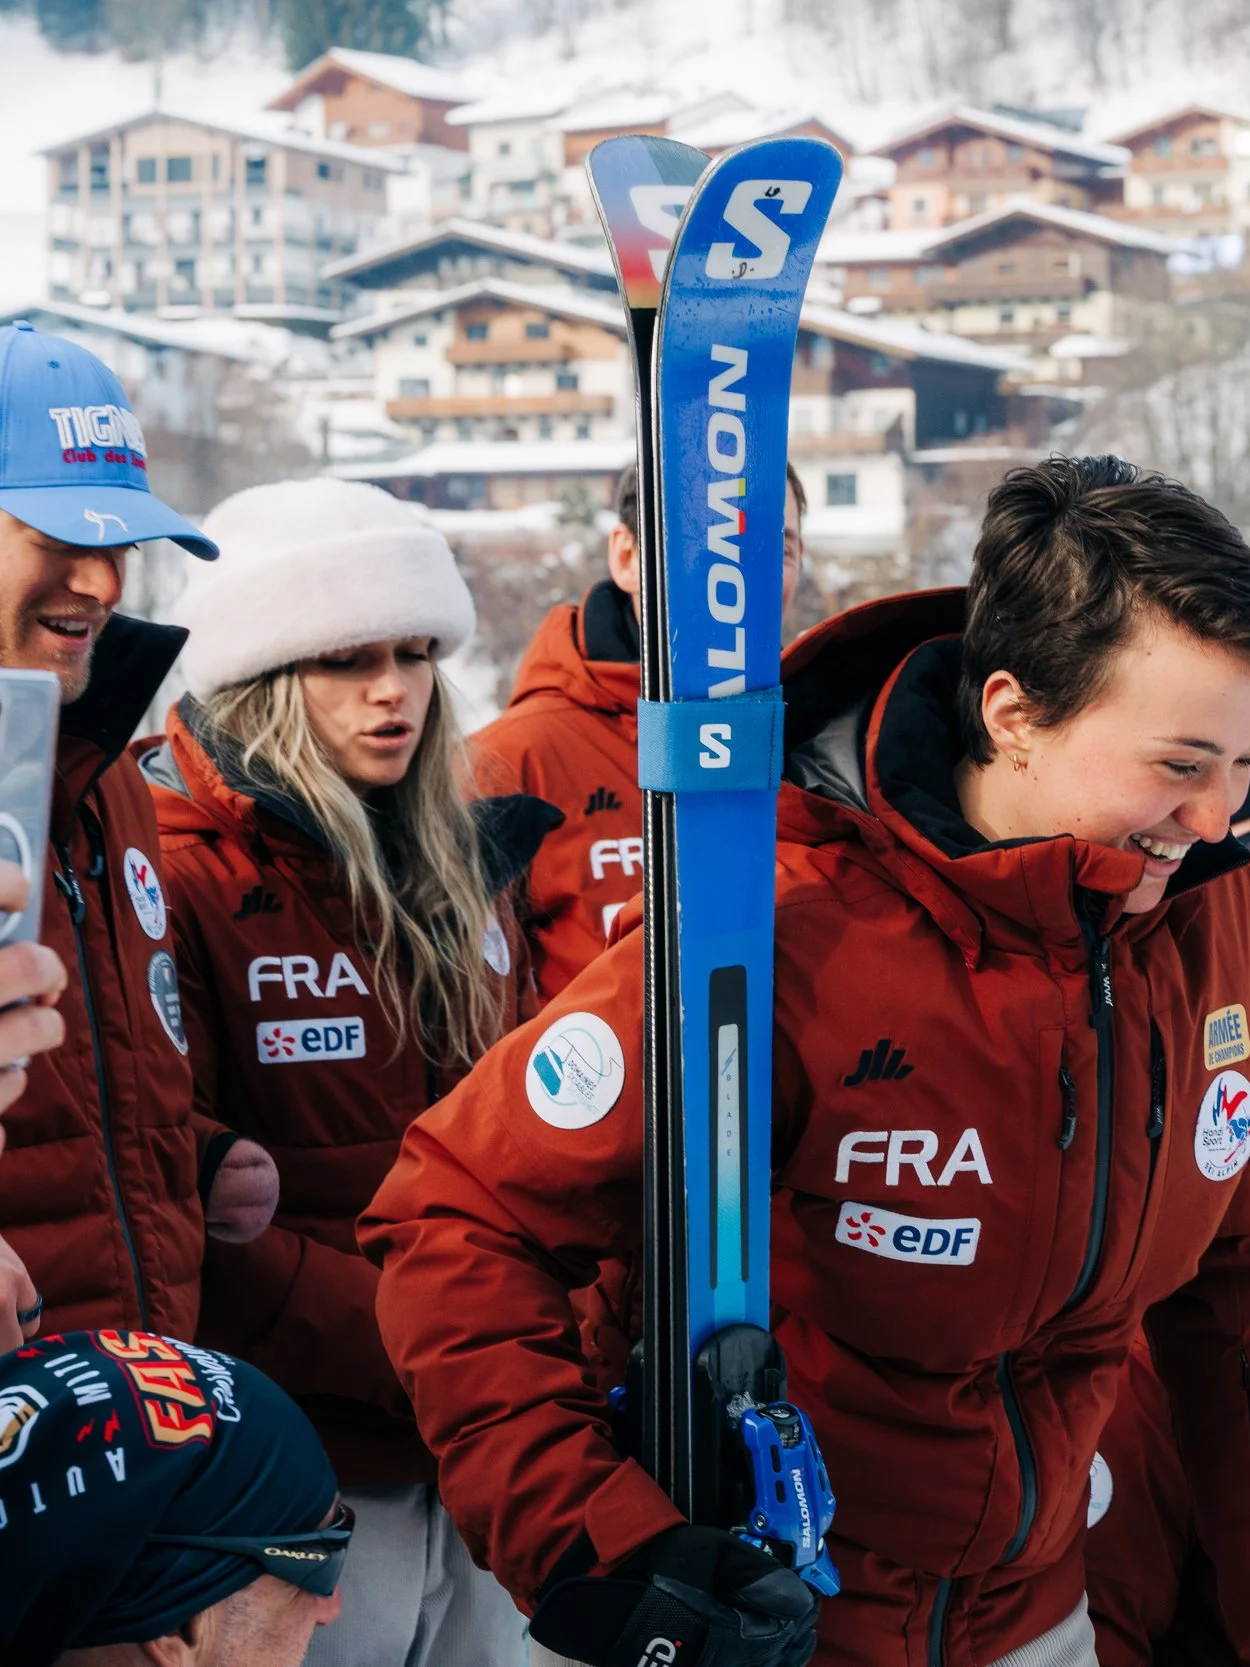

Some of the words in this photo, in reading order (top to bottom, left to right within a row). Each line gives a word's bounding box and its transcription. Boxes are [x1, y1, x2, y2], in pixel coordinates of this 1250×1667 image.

[707, 343, 749, 698] LOMON
[699, 723, 732, 769] S
[589, 837, 644, 880] FR
[247, 952, 370, 1002] FRA
[1208, 1009, 1243, 1050] ARMÉE
[834, 1127, 994, 1187] FRA
[791, 1468, 811, 1550] SALOMON
[263, 1547, 328, 1562] OAKLEY
